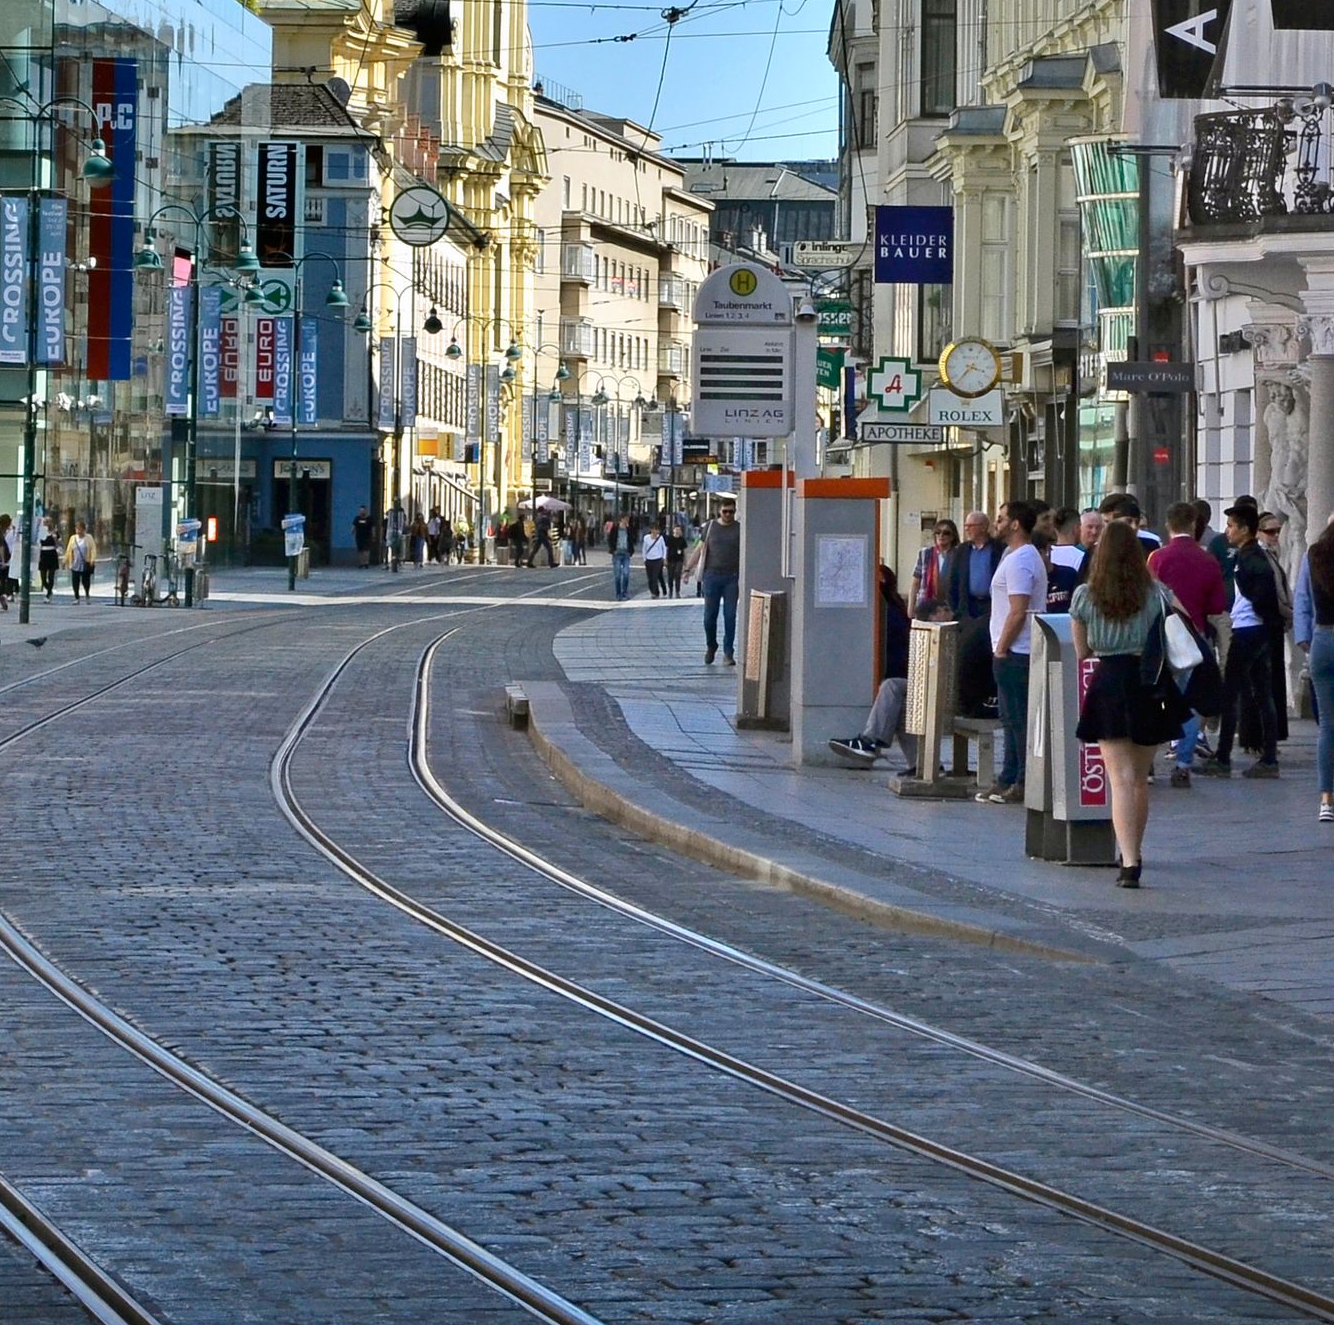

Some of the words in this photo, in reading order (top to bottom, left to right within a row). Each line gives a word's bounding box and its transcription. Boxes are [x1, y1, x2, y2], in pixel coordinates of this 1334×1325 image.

[265, 143, 288, 219] SATURN
[796, 255, 853, 265] Sprachschul
[811, 242, 848, 253] inling
[880, 234, 947, 246] KLEIDER
[880, 246, 947, 259] BAUER
[2, 204, 23, 343] CROSSING
[737, 273, 750, 291] H
[42, 251, 62, 360] EUROPE
[713, 301, 772, 311] Taubenmarkt
[170, 290, 187, 398] CROSSING
[202, 327, 218, 413] EUROPE
[258, 320, 274, 382] EURO
[275, 321, 290, 411] CROSSING
[301, 351, 315, 423] EUROPE
[380, 340, 393, 418] CROSSING
[402, 367, 416, 426] EUROPE
[468, 366, 478, 434] CROSSING
[1111, 371, 1146, 382] Marc
[487, 389, 498, 442] EUROPE
[522, 399, 532, 456] CROSSING
[538, 417, 548, 464] EUROPE
[724, 409, 760, 418] LINZ
[762, 409, 784, 418] AG
[867, 426, 941, 441] APOTHEKE
[938, 410, 993, 422] ROLEX
